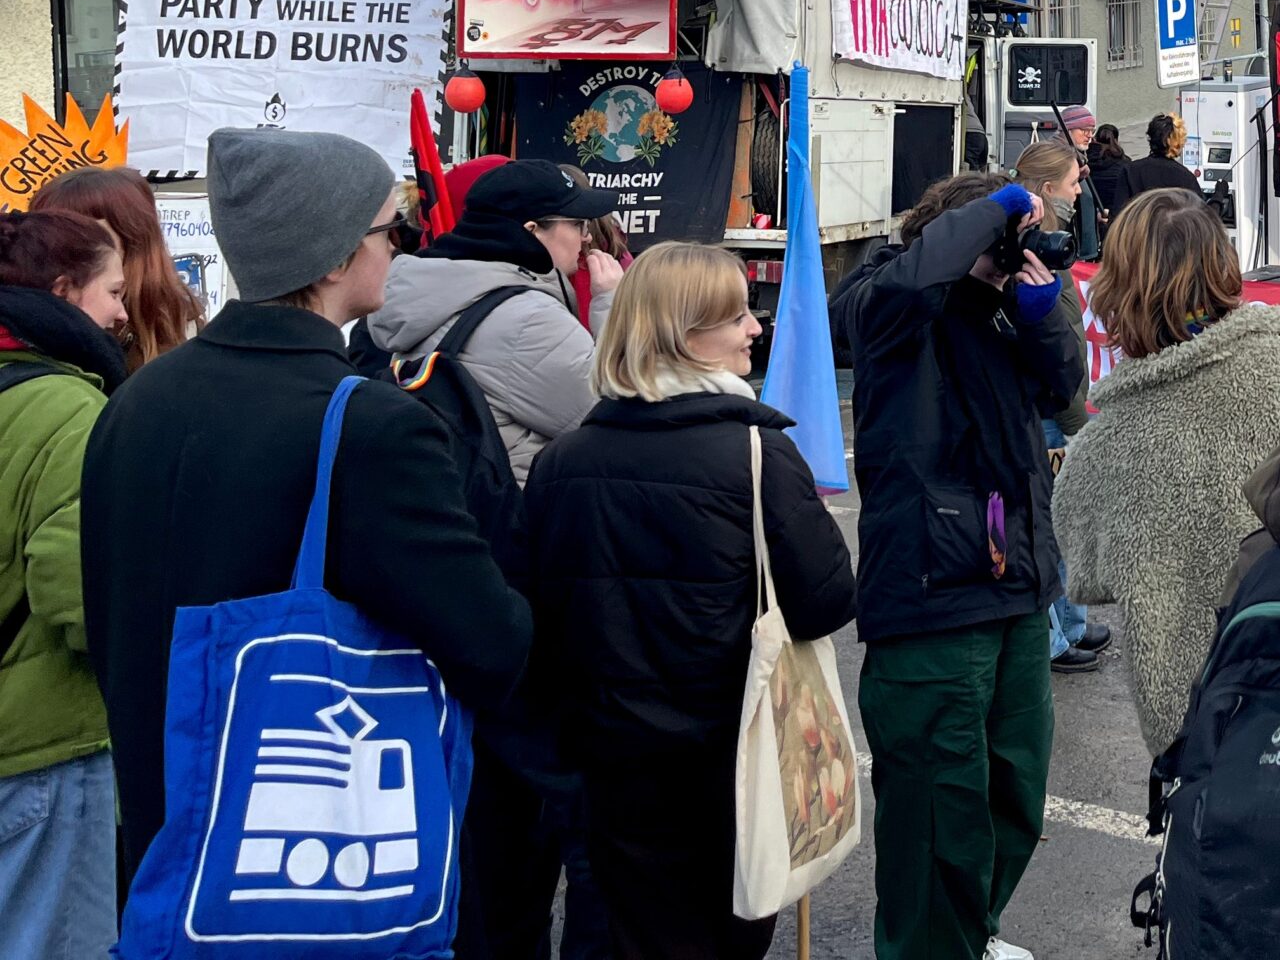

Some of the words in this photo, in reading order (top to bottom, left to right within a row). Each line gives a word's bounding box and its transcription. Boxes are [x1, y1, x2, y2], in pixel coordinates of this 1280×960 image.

[276, 0, 357, 23] WHILE
[365, 2, 412, 25] THE
[156, 28, 278, 60] WORLD
[290, 32, 409, 64] BURNS
[578, 66, 648, 98] DESTROY
[0, 123, 73, 195] GREEN
[585, 171, 664, 189] TRIARCHY
[611, 209, 661, 234] NET
